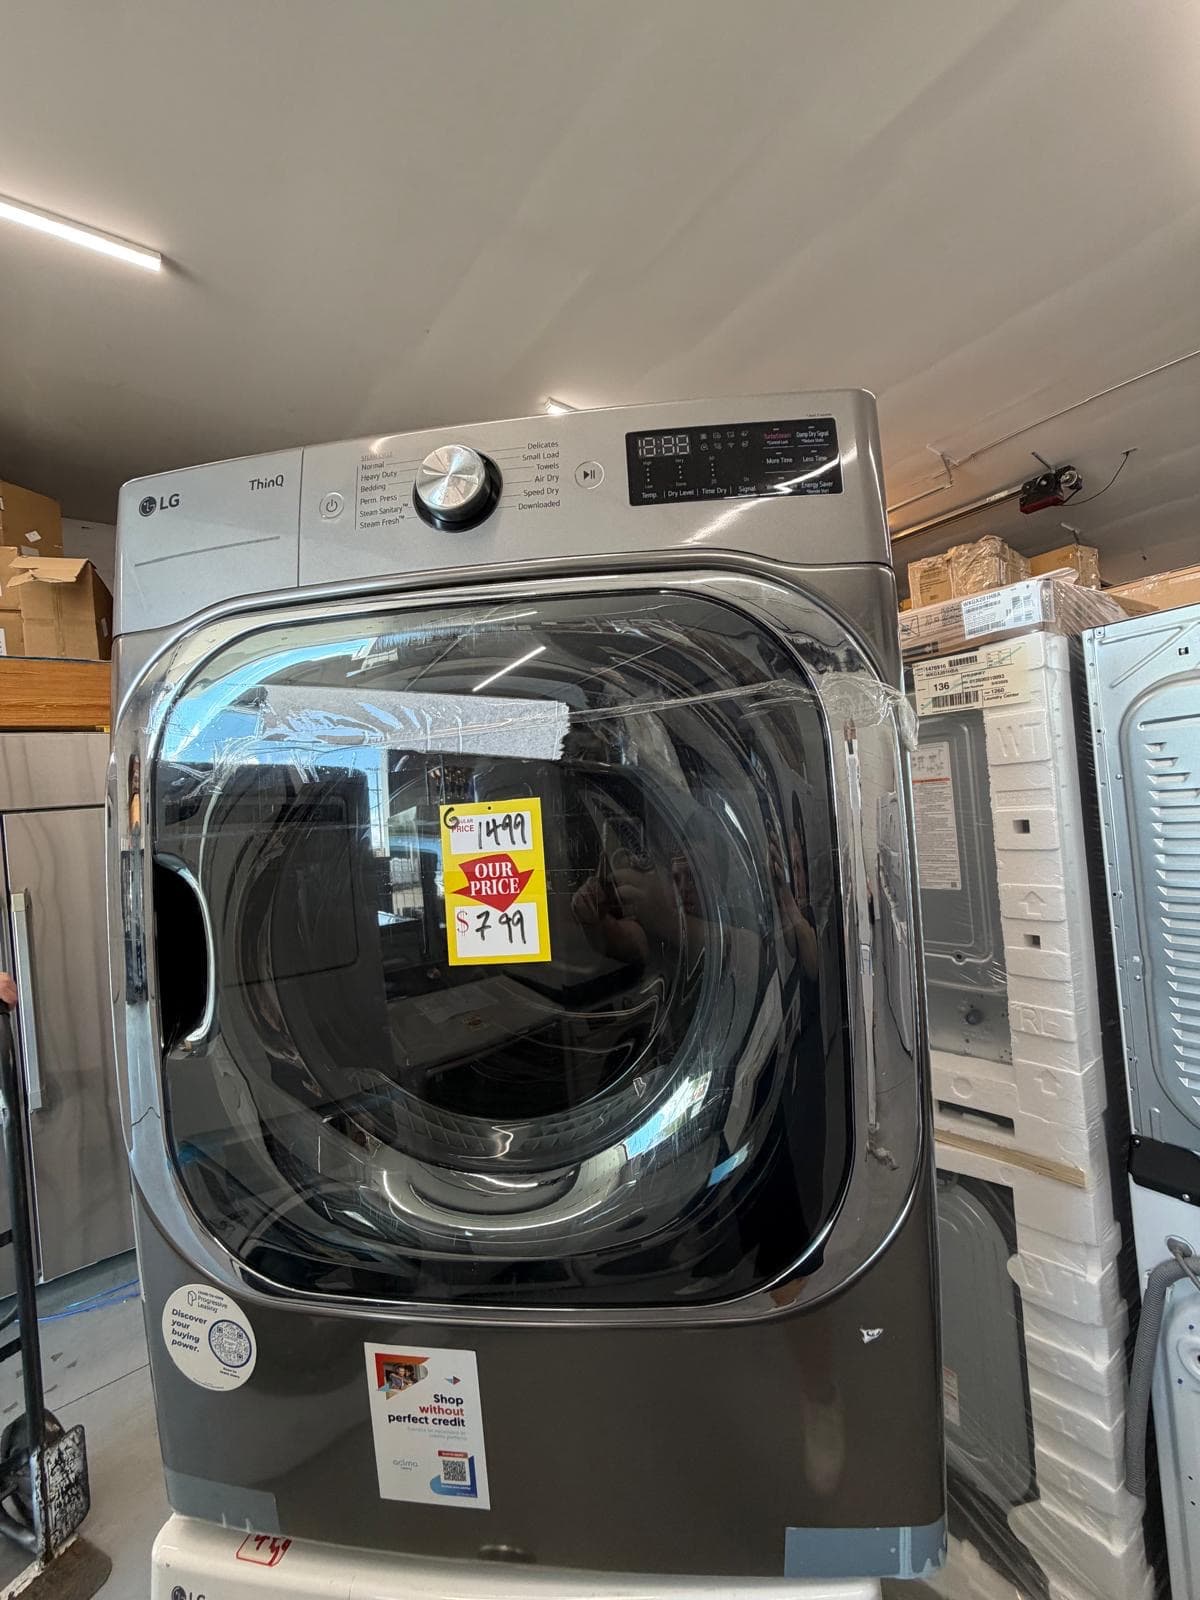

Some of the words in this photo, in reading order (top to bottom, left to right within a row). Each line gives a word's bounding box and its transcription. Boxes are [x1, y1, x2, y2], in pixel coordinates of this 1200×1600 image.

[527, 441, 559, 450] Delicates
[522, 452, 541, 461] Small
[542, 450, 560, 459] Load
[361, 461, 384, 471] Normal
[537, 462, 560, 470] Towels
[360, 473, 380, 482] Heavy
[382, 471, 397, 480] Duty
[534, 475, 544, 483] Air
[546, 474, 560, 483] Dry
[249, 474, 284, 491] ThinQ
[360, 484, 386, 493] Bedding
[523, 488, 544, 498] Speed
[546, 488, 560, 496] Dry
[159, 494, 180, 512] LG
[380, 495, 398, 503] Press
[518, 500, 560, 511] Downloaded
[360, 510, 378, 518] Steam
[360, 521, 380, 530] Steam
[934, 682, 950, 692] 136
[452, 824, 475, 833] PRICE
[478, 812, 527, 849] 1499
[475, 862, 514, 878] OUR
[470, 878, 520, 896] PRICE
[476, 910, 526, 944] 799
[172, 1308, 208, 1325] Discover
[171, 1319, 190, 1330] your
[172, 1328, 200, 1344] buying
[171, 1339, 200, 1353] power.
[433, 1394, 464, 1406] Shop
[419, 1405, 464, 1416] without
[388, 1414, 429, 1424] perfect
[432, 1417, 466, 1427] credit
